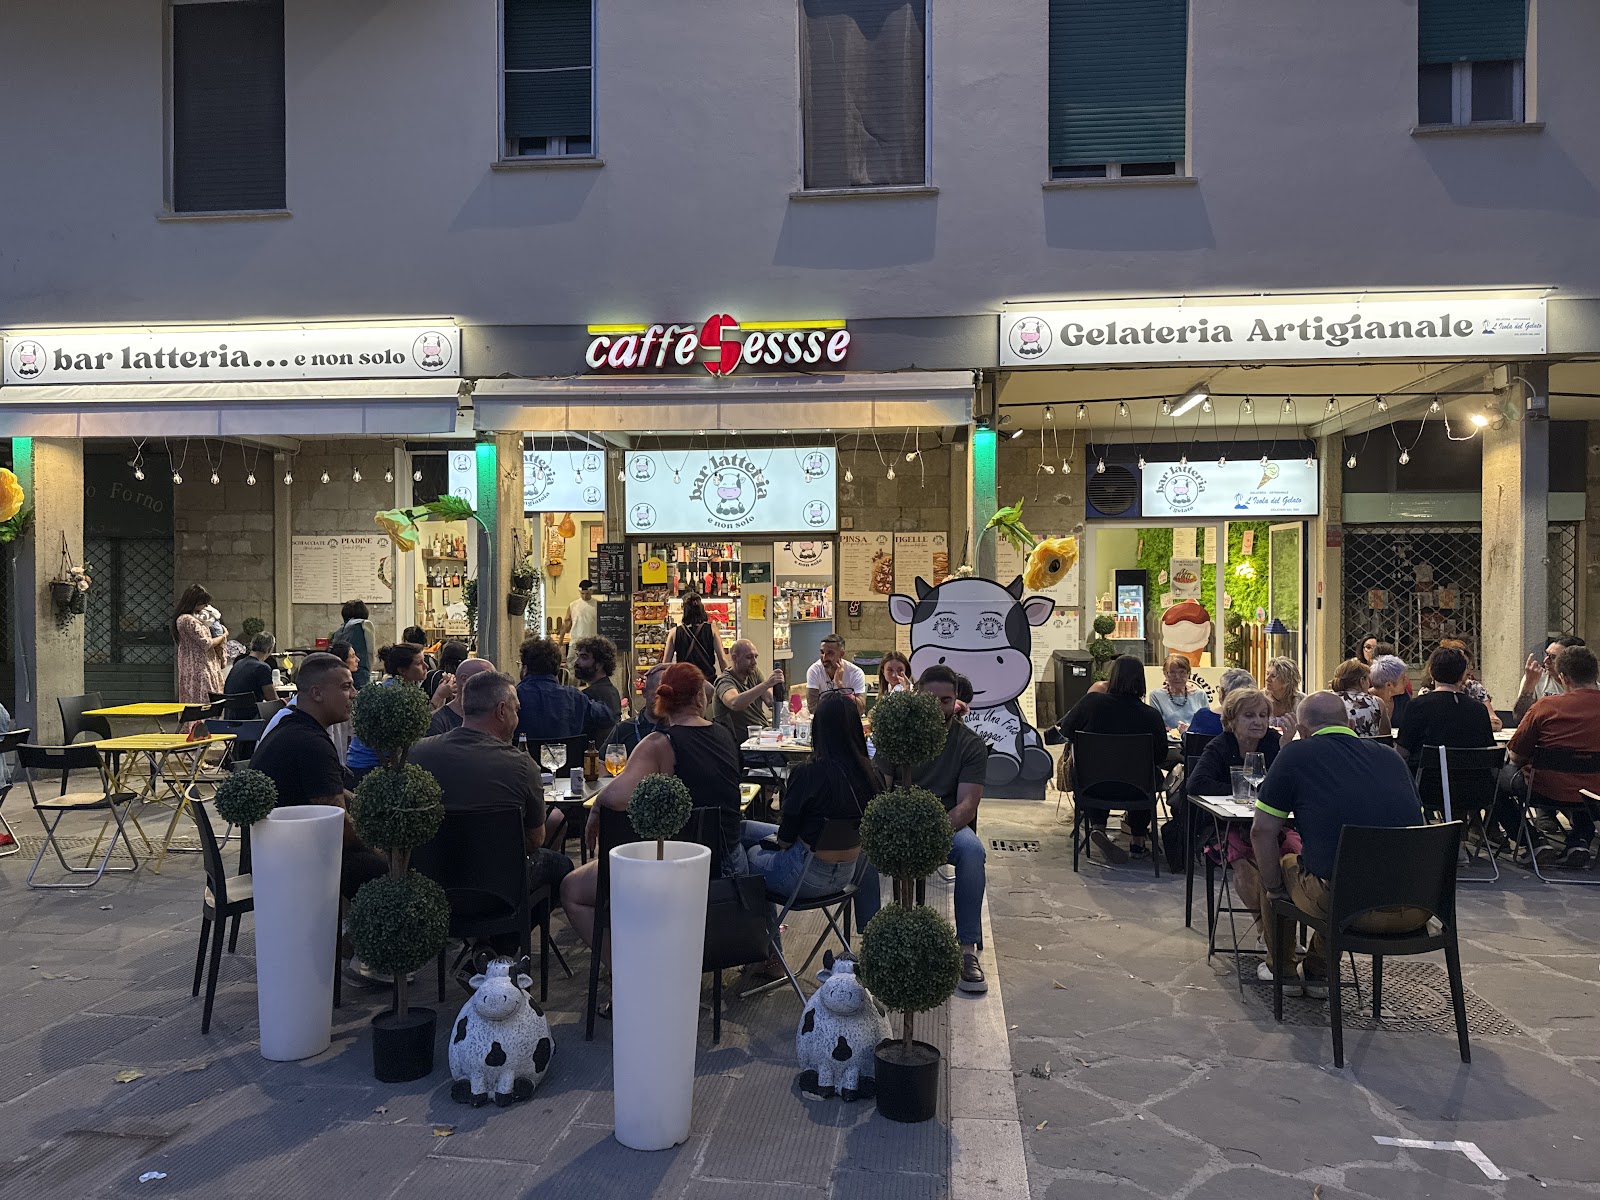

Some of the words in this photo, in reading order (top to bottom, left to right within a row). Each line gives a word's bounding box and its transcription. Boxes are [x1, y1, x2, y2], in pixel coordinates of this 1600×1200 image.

[1060, 319, 1233, 346] Gelateria
[1246, 313, 1474, 347] Artigianale
[1524, 322, 1542, 331] Gelato
[53, 348, 114, 370] bar
[294, 354, 306, 366] e
[311, 352, 353, 366] non
[358, 348, 406, 365] solo
[689, 465, 708, 501] bar
[709, 454, 770, 500] latteria
[1156, 470, 1169, 494] bar
[1169, 465, 1208, 493] latteria
[110, 482, 164, 512] Forno
[1282, 496, 1302, 506] Gelato
[735, 516, 755, 528] solo
[1189, 672, 1215, 703] teria
[965, 710, 980, 723] atta
[983, 708, 1000, 724] Una
